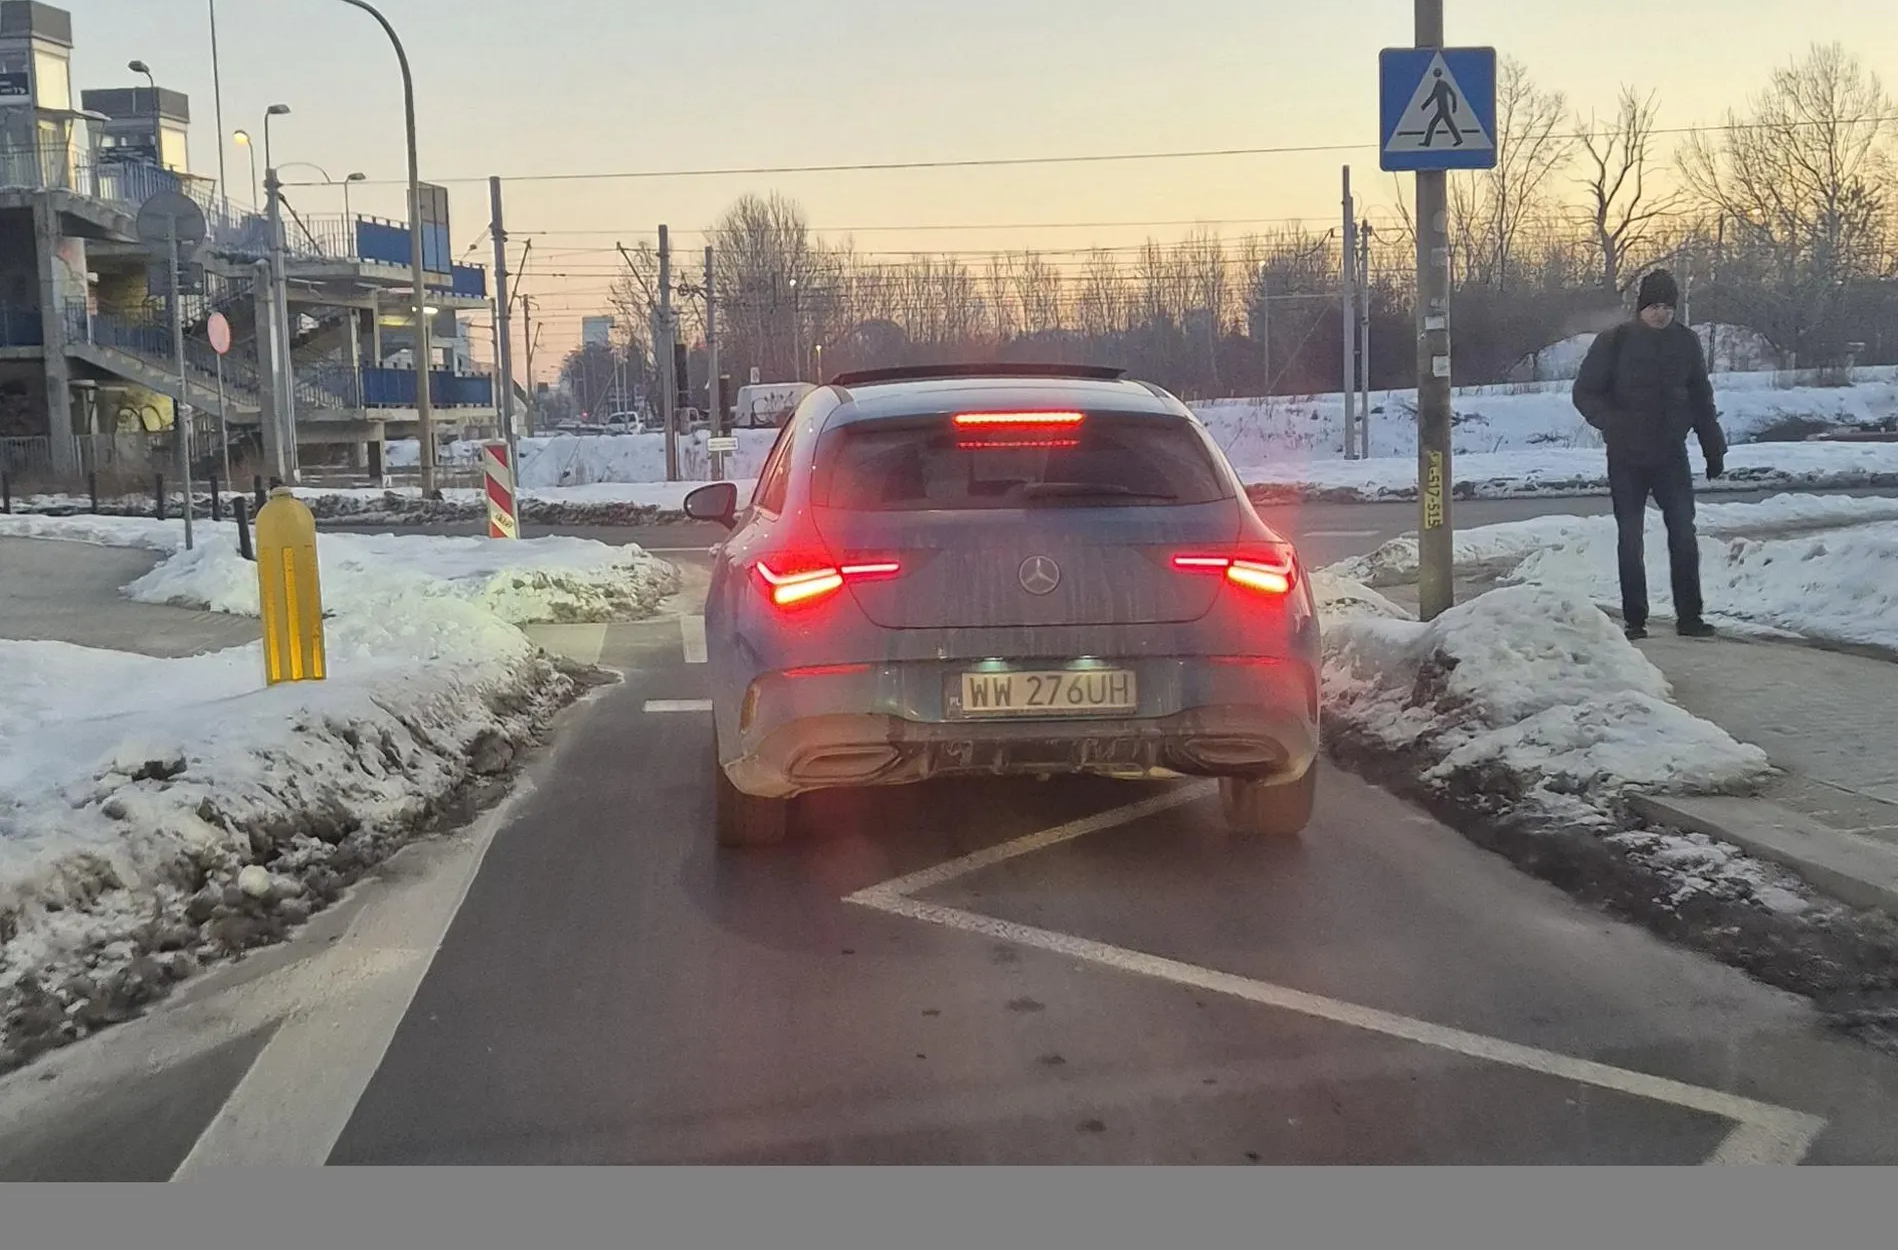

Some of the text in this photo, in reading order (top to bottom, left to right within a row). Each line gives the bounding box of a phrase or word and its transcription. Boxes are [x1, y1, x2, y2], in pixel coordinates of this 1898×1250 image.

[949, 696, 962, 706] PL
[968, 674, 1129, 708] WW 276UH
